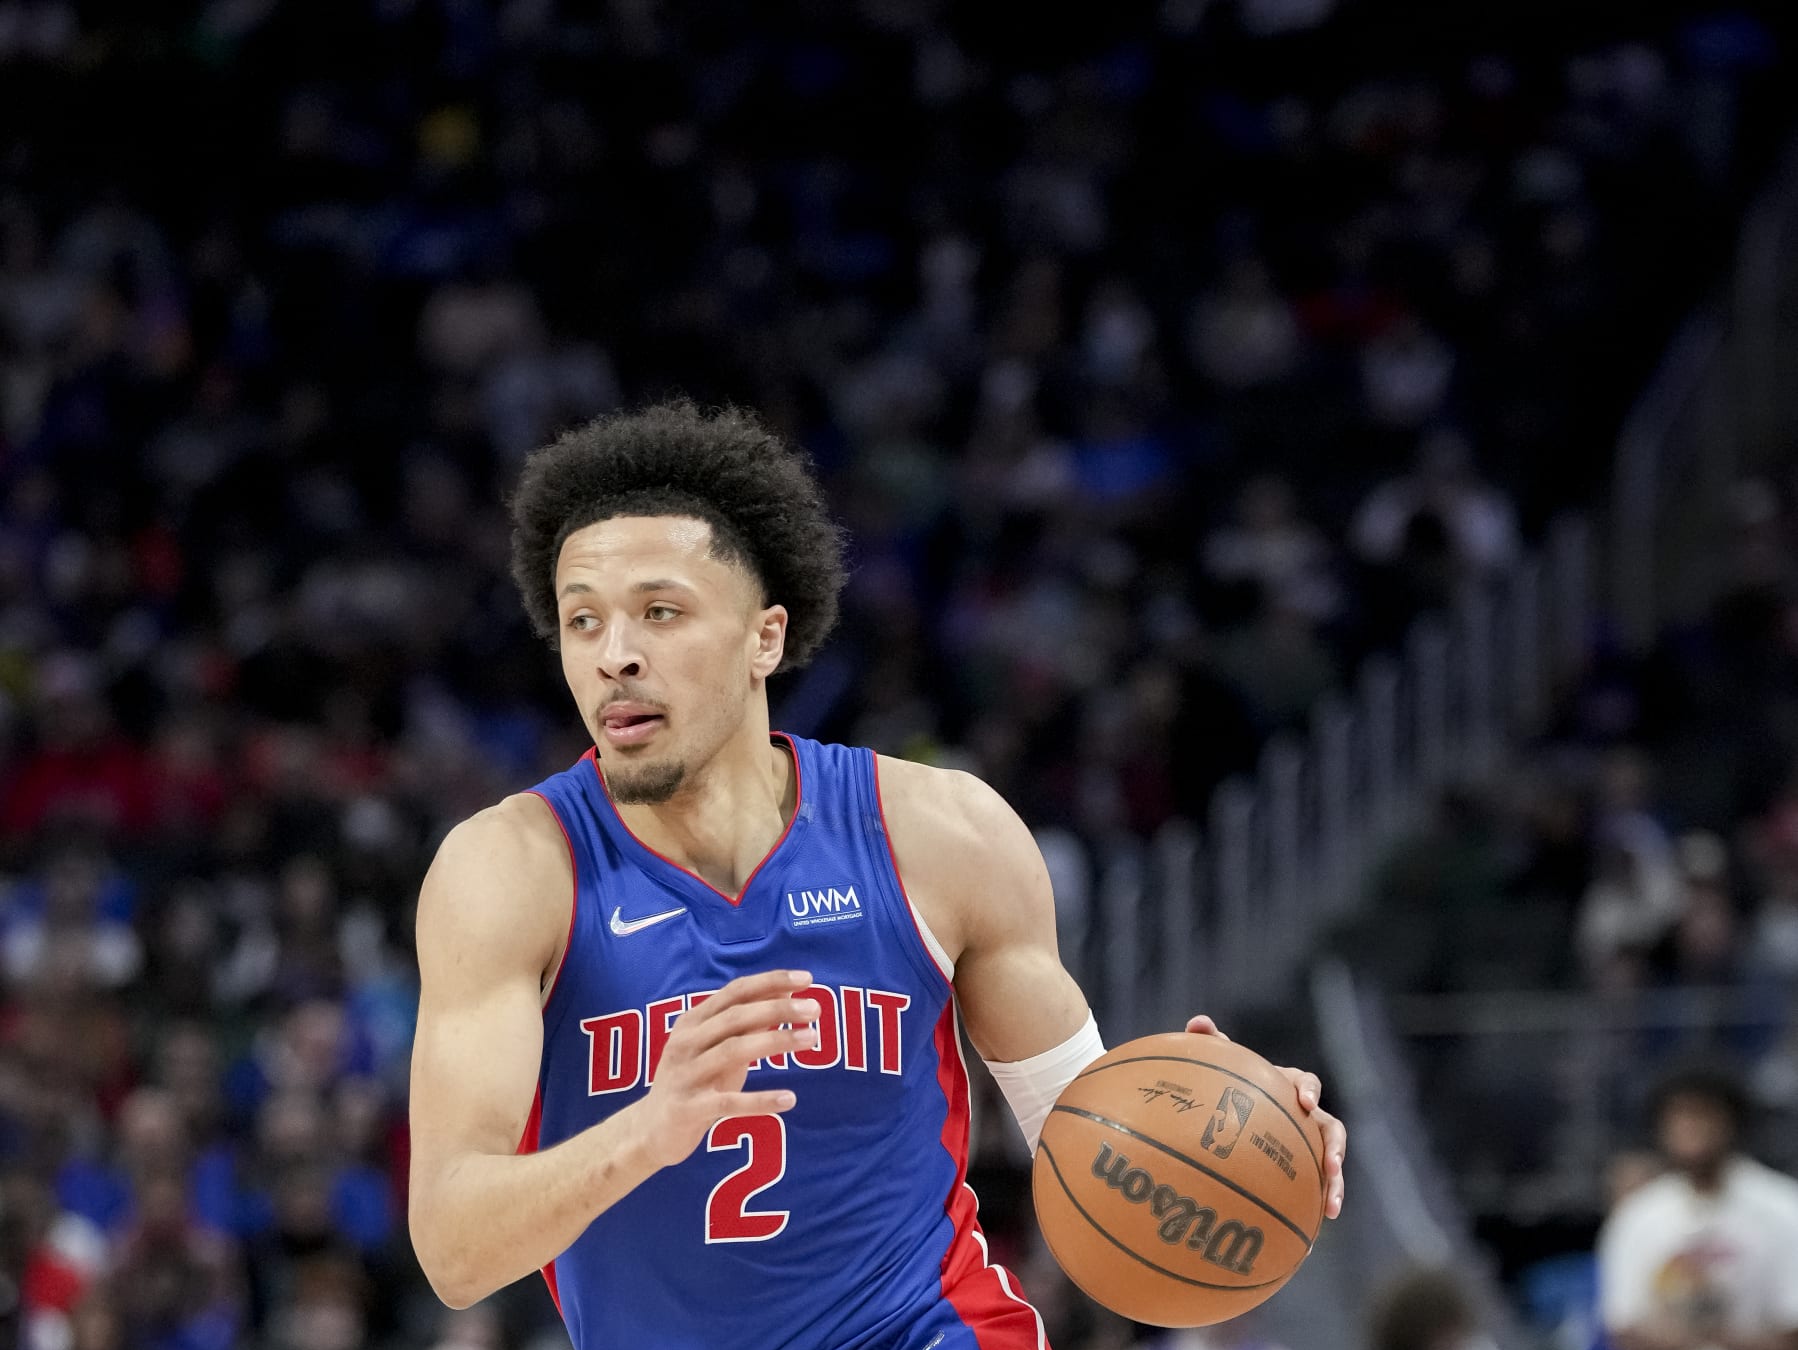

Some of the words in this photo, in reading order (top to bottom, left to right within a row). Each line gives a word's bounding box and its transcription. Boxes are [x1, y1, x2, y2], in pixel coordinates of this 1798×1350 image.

[788, 885, 860, 916] UWM
[580, 984, 911, 1096] DEOIT
[705, 1112, 790, 1244] 2
[1091, 1141, 1264, 1276] Wilson
